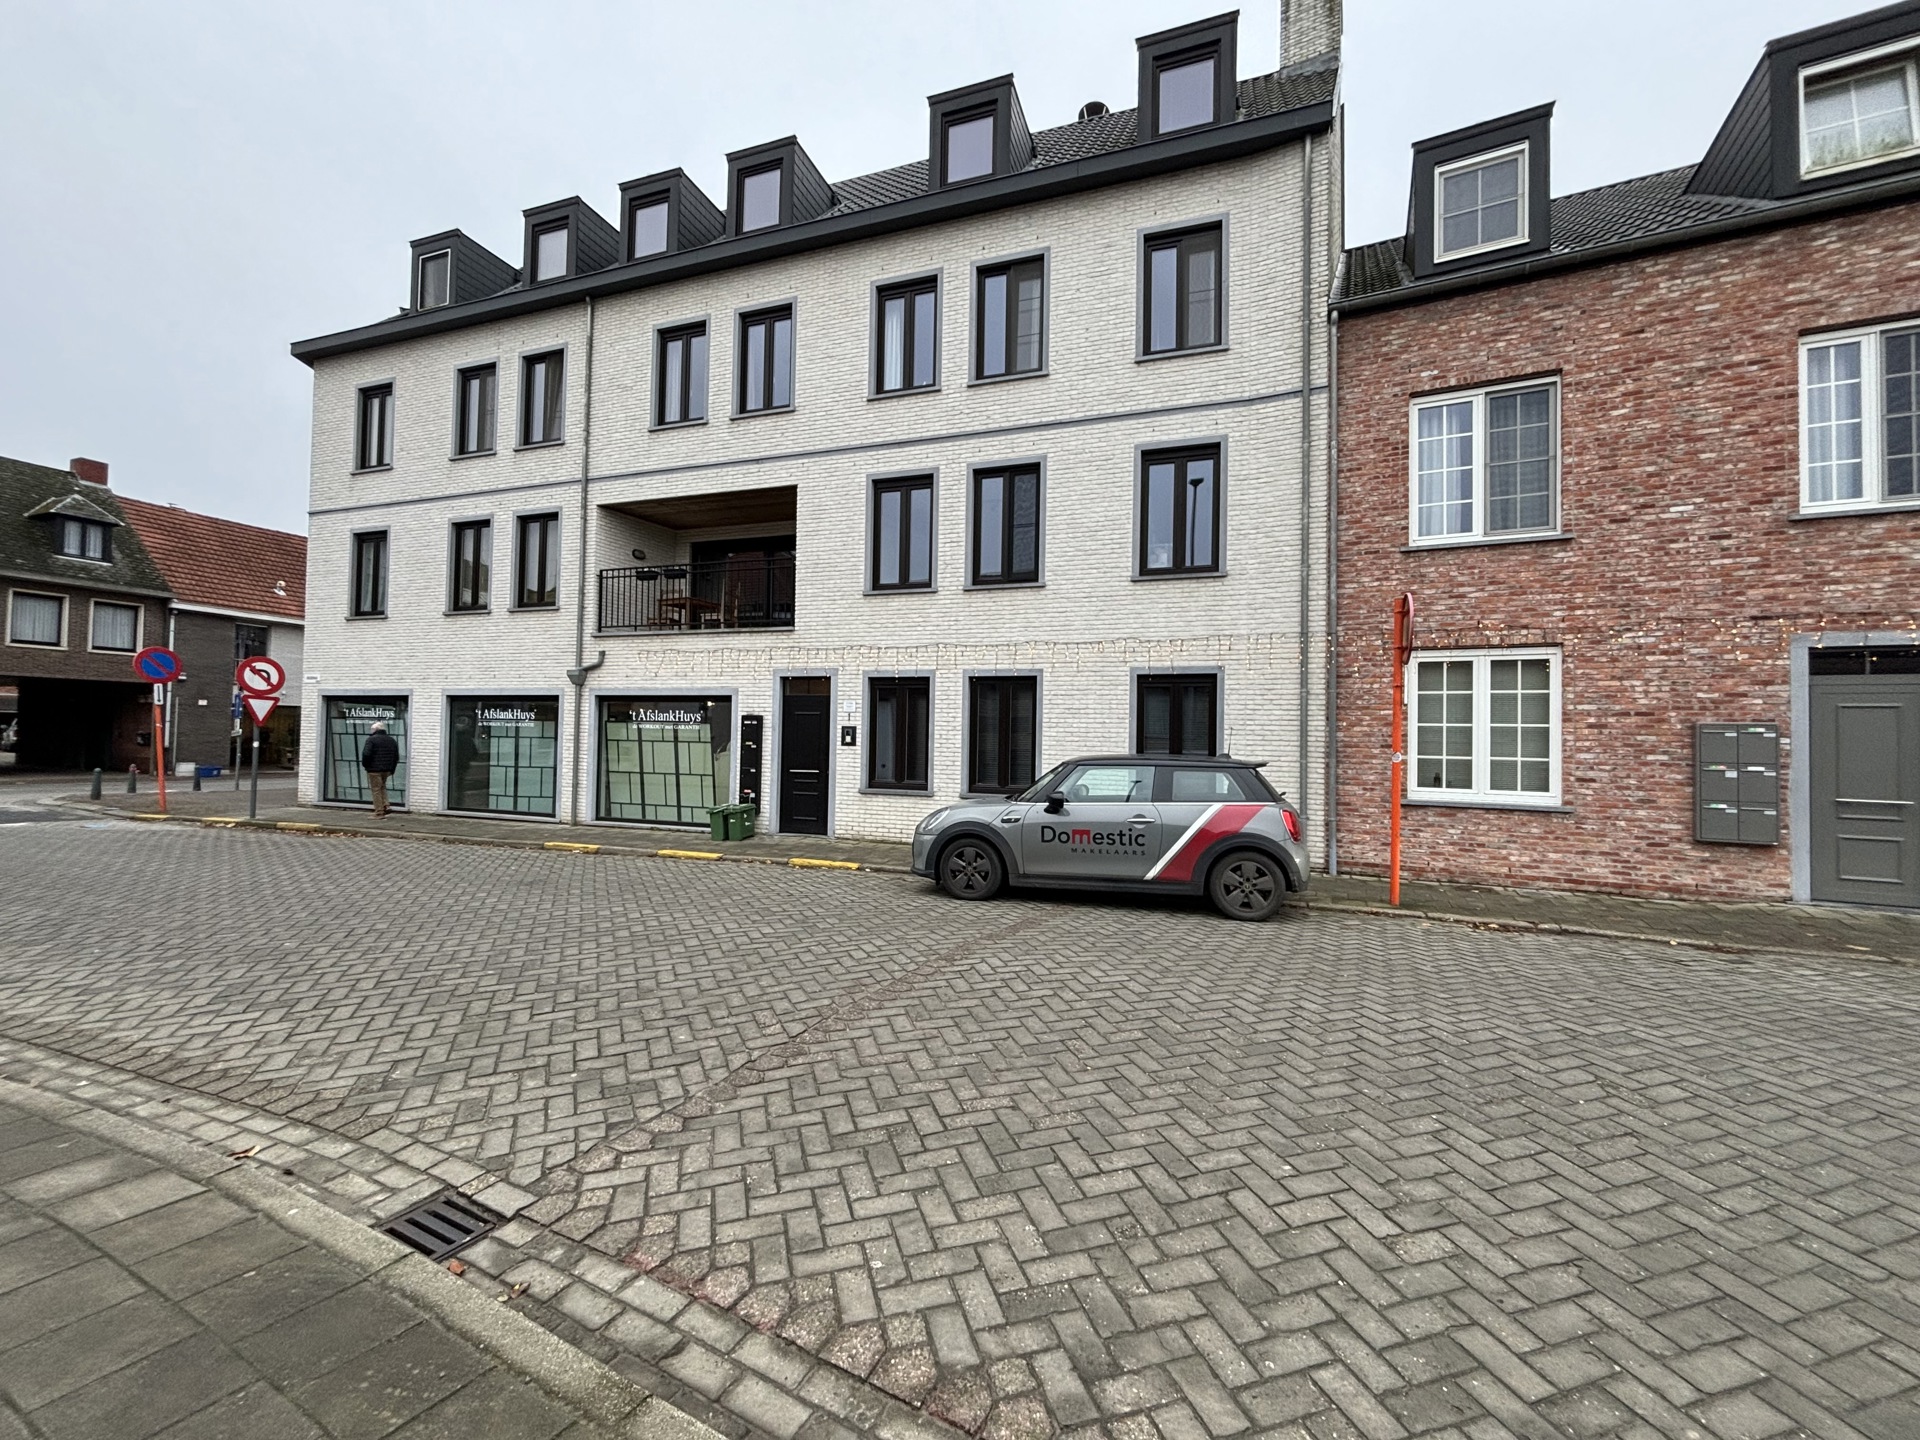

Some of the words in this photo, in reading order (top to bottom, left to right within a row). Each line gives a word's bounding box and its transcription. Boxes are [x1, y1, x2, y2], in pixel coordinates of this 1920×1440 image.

[349, 707, 395, 720] AfslankHuys
[482, 708, 535, 722] AfslankHuys
[638, 709, 702, 725] AfslankHuys
[1040, 825, 1146, 847] Domestic
[1071, 847, 1146, 856] MAKELAARS
